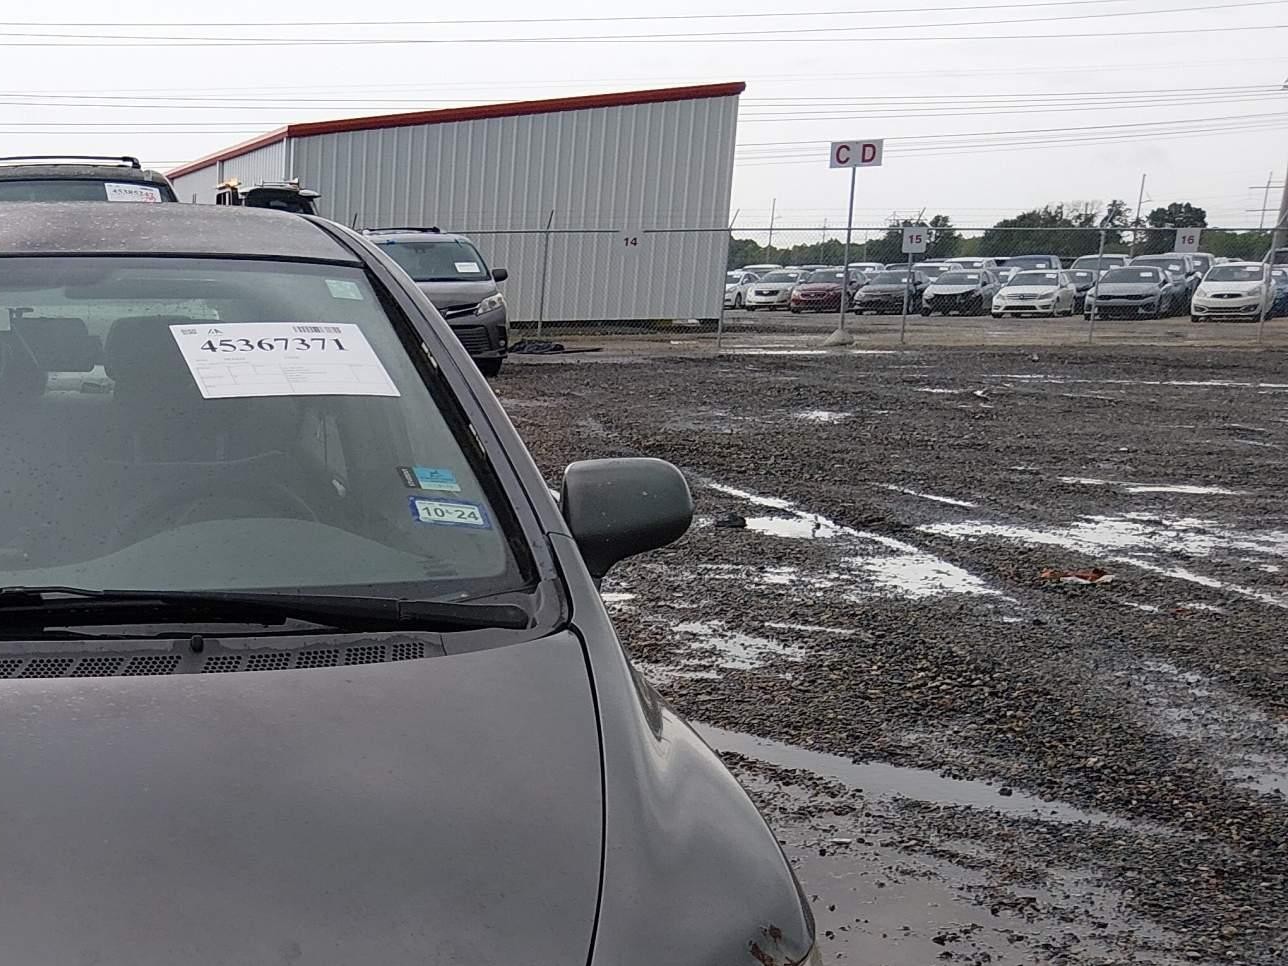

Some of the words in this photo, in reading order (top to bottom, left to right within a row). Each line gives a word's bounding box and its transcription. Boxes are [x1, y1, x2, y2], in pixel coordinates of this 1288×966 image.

[835, 144, 851, 165] C
[861, 143, 877, 163] D
[623, 236, 640, 248] 14
[908, 233, 923, 244] 15
[1181, 235, 1195, 245] 16
[200, 337, 350, 353] 45367371
